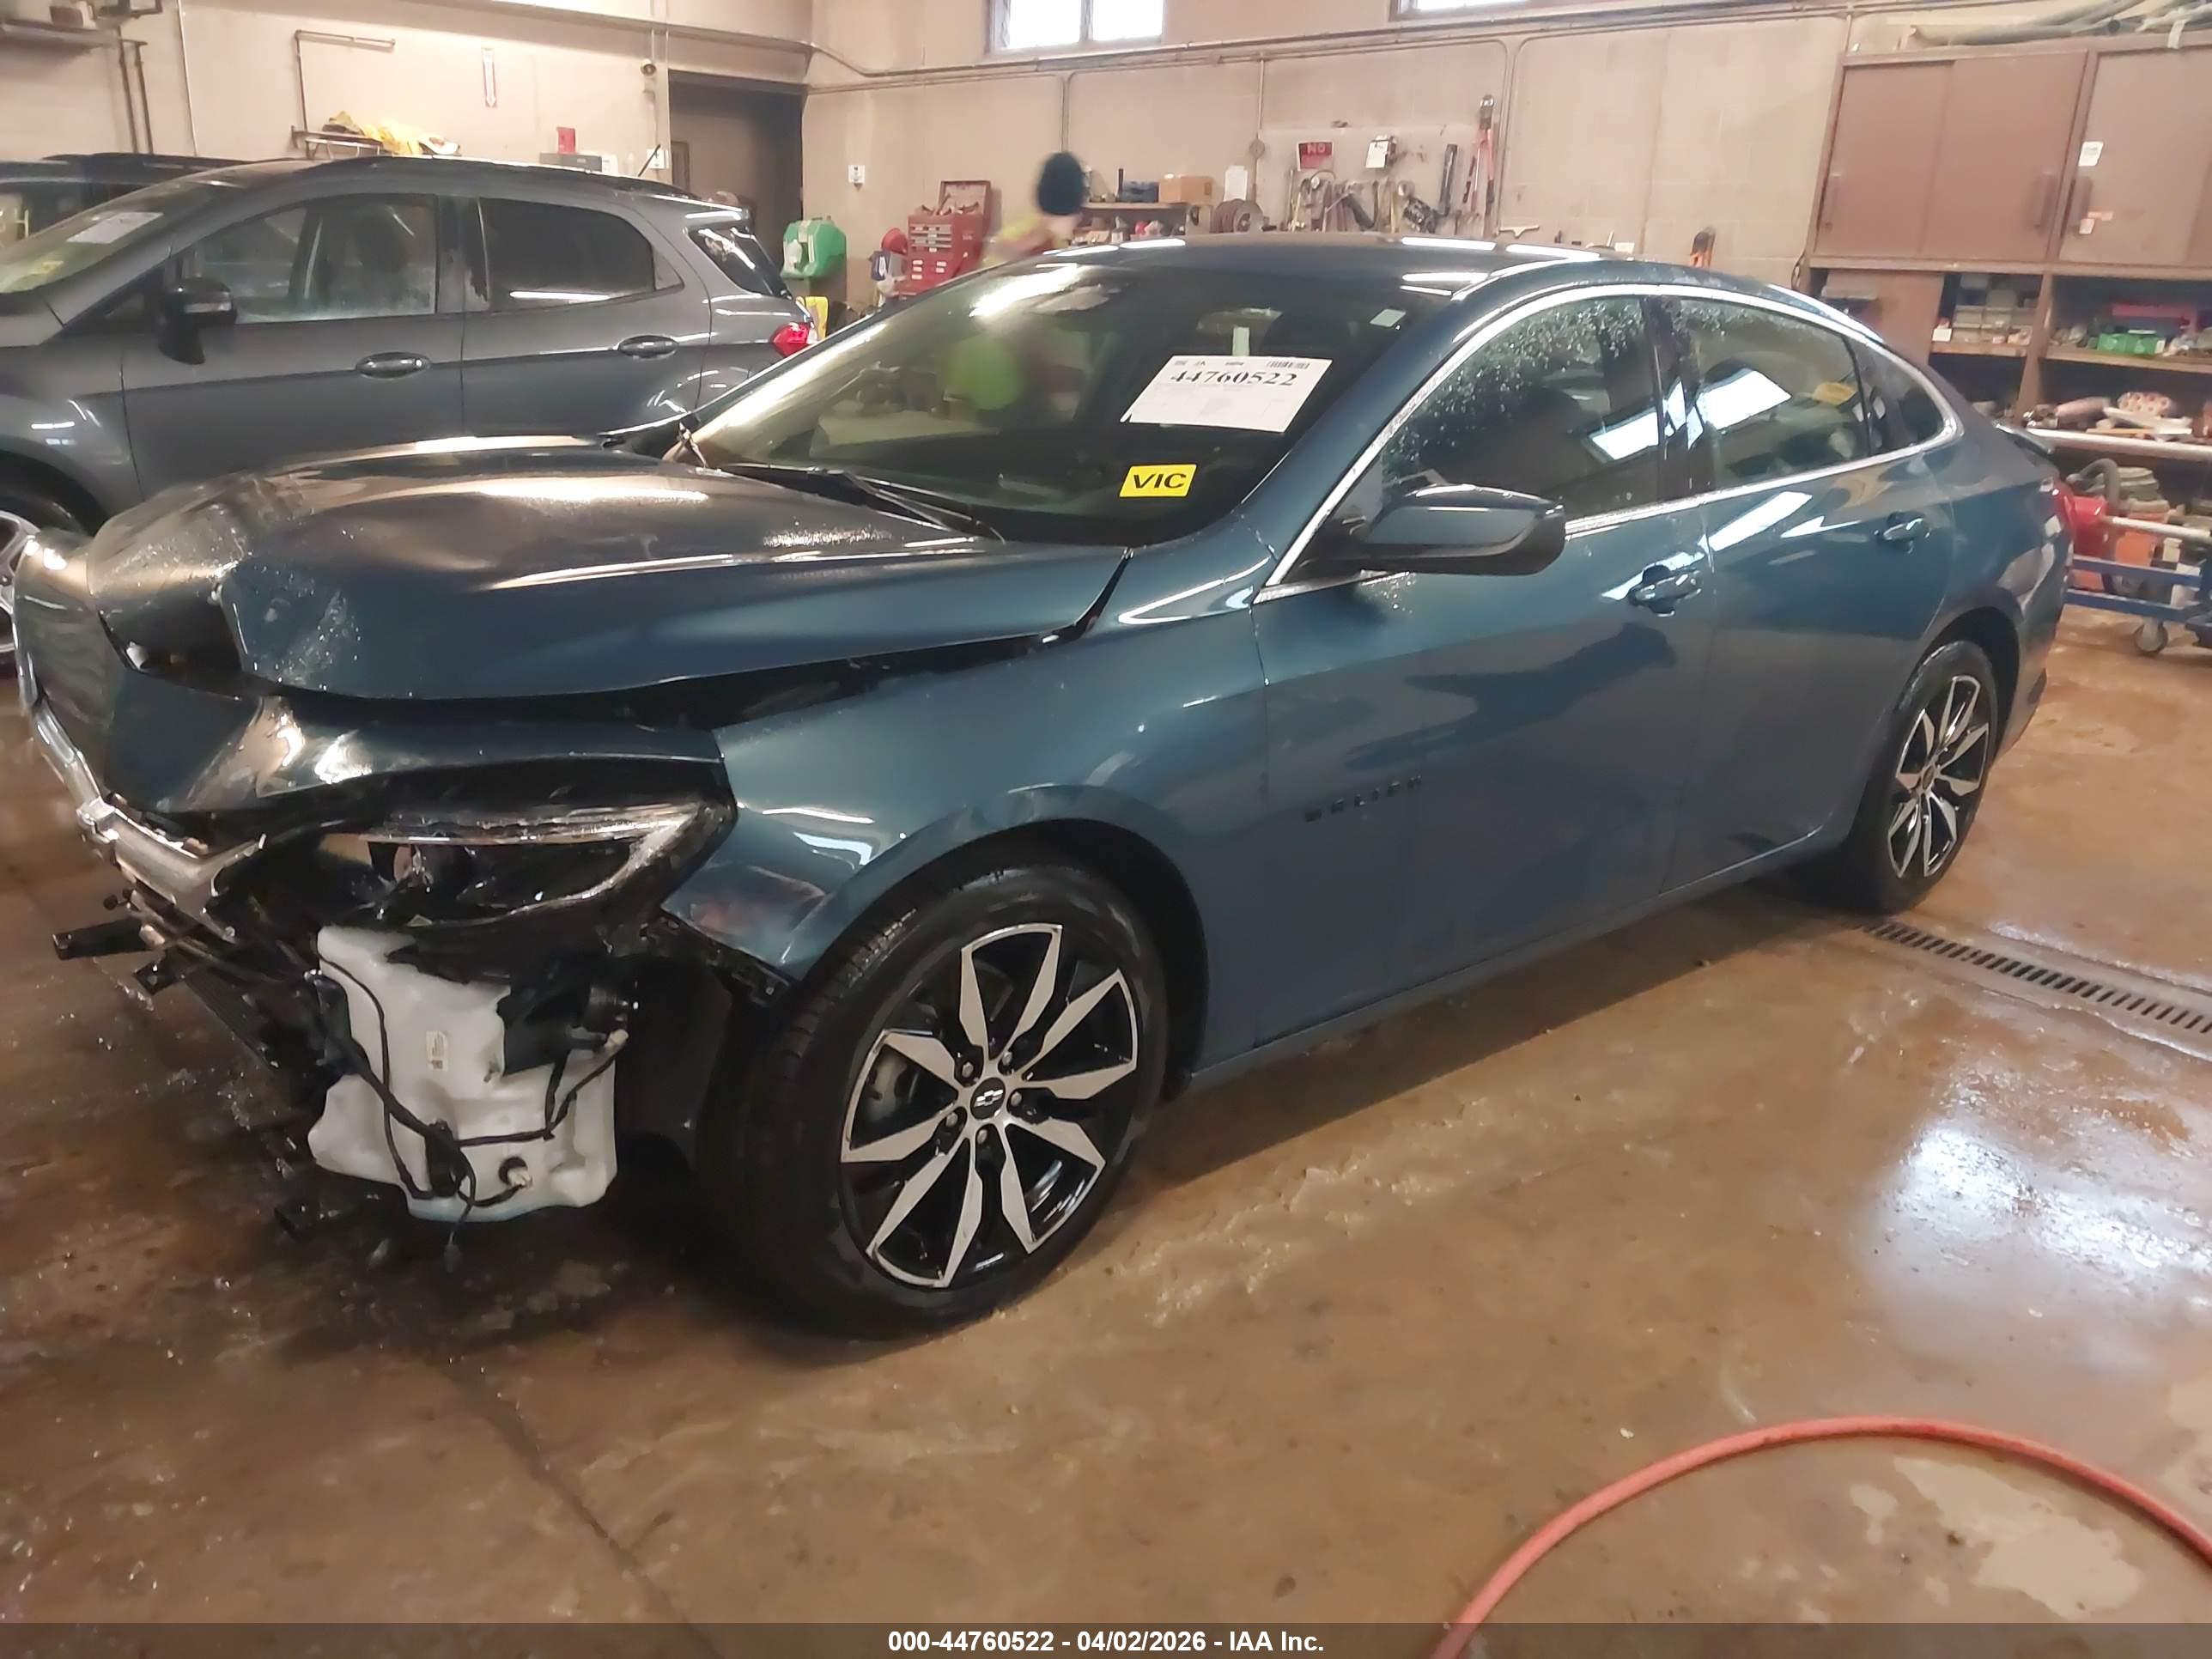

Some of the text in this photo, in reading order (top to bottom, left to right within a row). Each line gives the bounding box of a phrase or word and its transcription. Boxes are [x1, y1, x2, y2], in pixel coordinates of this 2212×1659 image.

[1307, 143, 1326, 155] NO
[1170, 370, 1297, 386] 44760522
[1133, 472, 1188, 489] VIC
